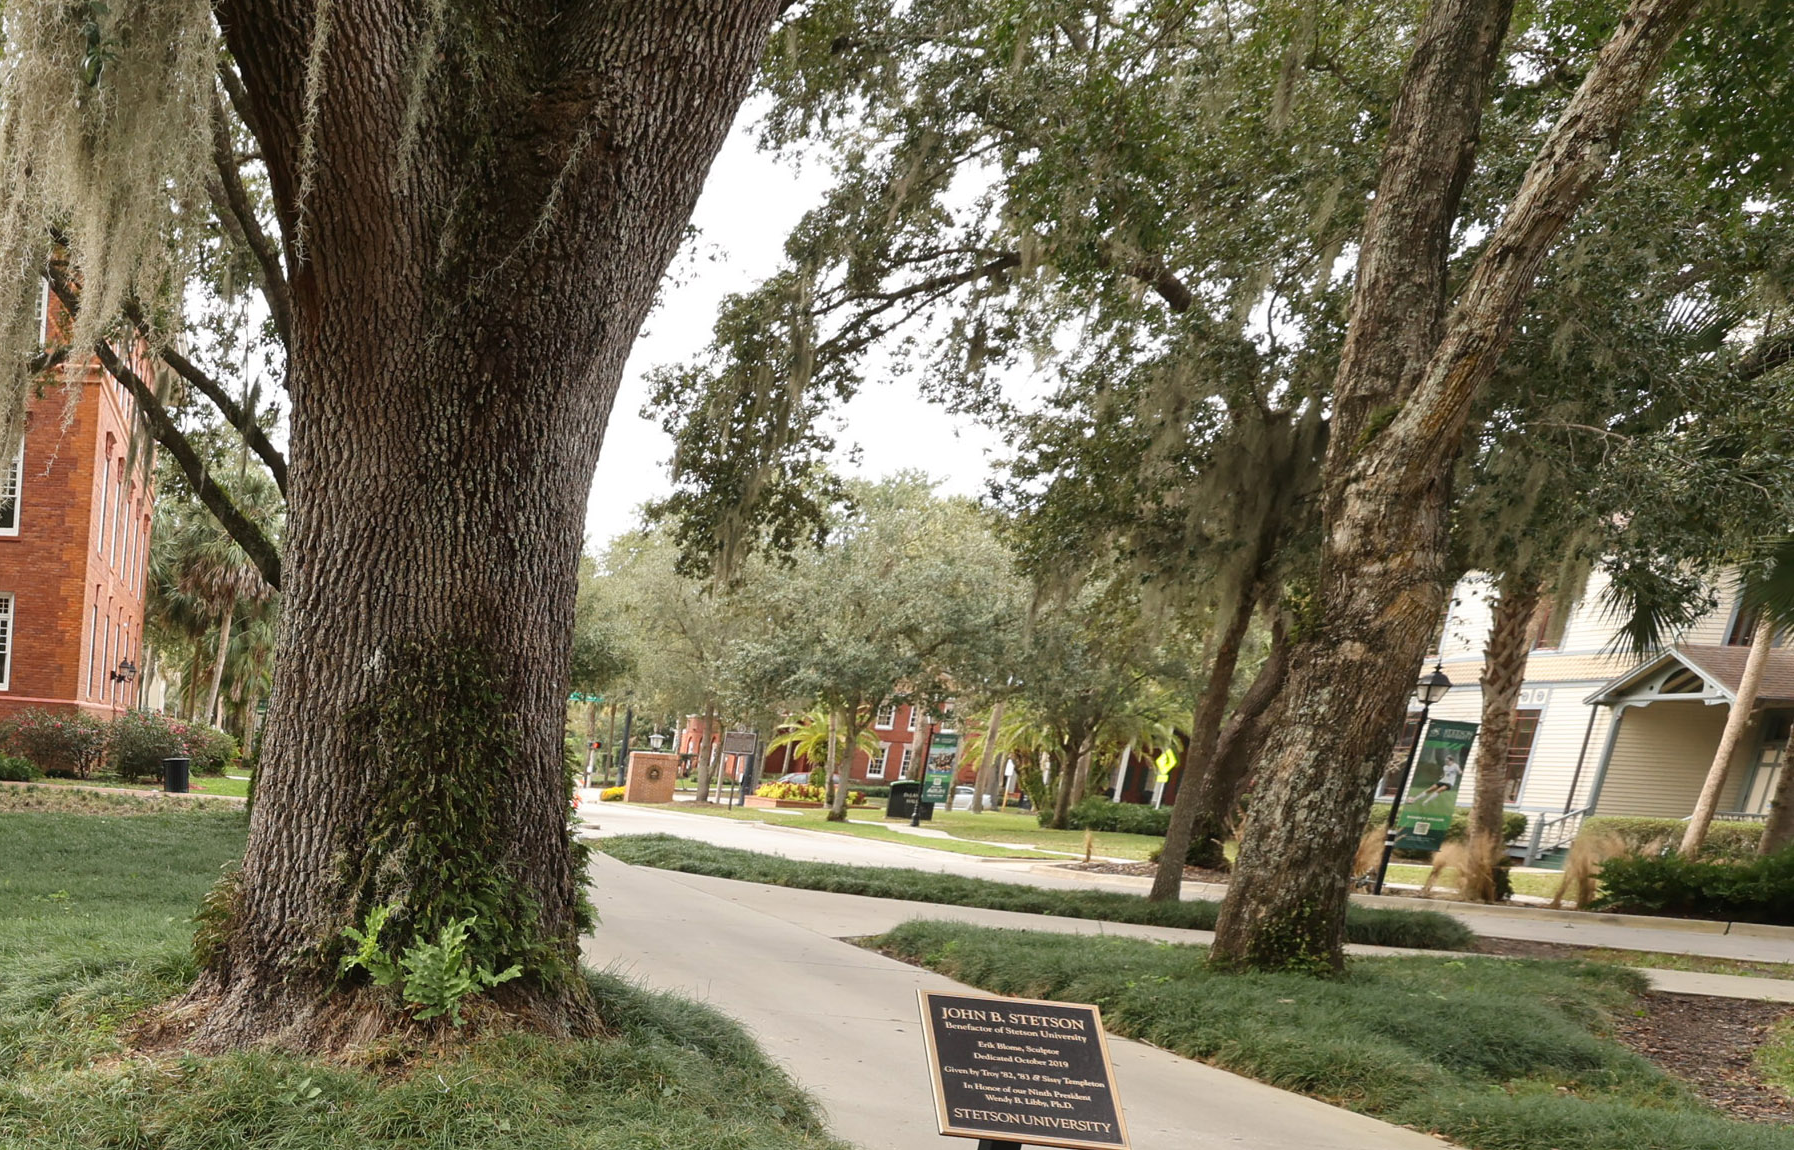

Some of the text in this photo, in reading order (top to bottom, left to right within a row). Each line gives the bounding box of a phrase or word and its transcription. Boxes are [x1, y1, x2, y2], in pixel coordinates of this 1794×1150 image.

[941, 1007, 1085, 1030] JOHN B. STETSON
[945, 1021, 1087, 1043] Benefactor of Stetson University
[978, 1041, 1060, 1055] Erik Blome, Sculptor
[973, 1052, 1069, 1068] Dedicated October 2019
[944, 1066, 968, 1075] Given
[969, 1068, 980, 1077] by
[980, 1069, 999, 1079] Troy
[1032, 1074, 1040, 1082] &
[1062, 1077, 1105, 1088] Templeton
[974, 1083, 1001, 1092] Honor
[1027, 1088, 1052, 1097] Ninth
[1053, 1091, 1092, 1102] President
[985, 1094, 1012, 1105] Wendy
[1025, 1098, 1049, 1108] Libby,
[954, 1107, 1112, 1133] STETSON UNIVERSITY
